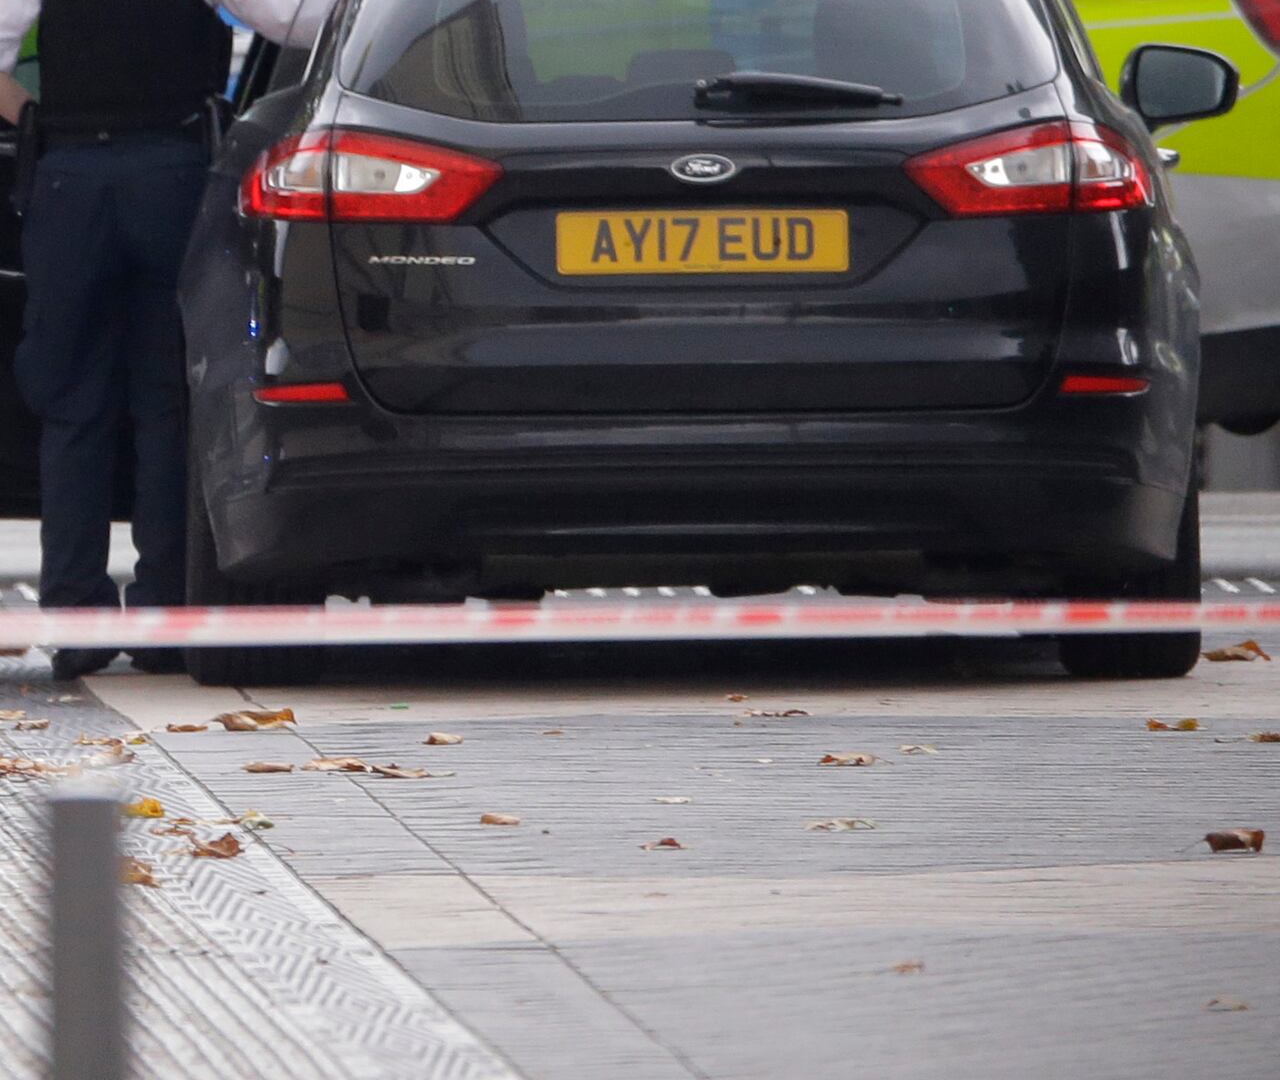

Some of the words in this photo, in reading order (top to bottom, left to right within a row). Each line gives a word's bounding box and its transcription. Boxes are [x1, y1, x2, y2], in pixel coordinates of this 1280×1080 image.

[591, 218, 700, 262] AY17
[717, 218, 815, 261] EUD
[367, 255, 476, 266] MONDEO
